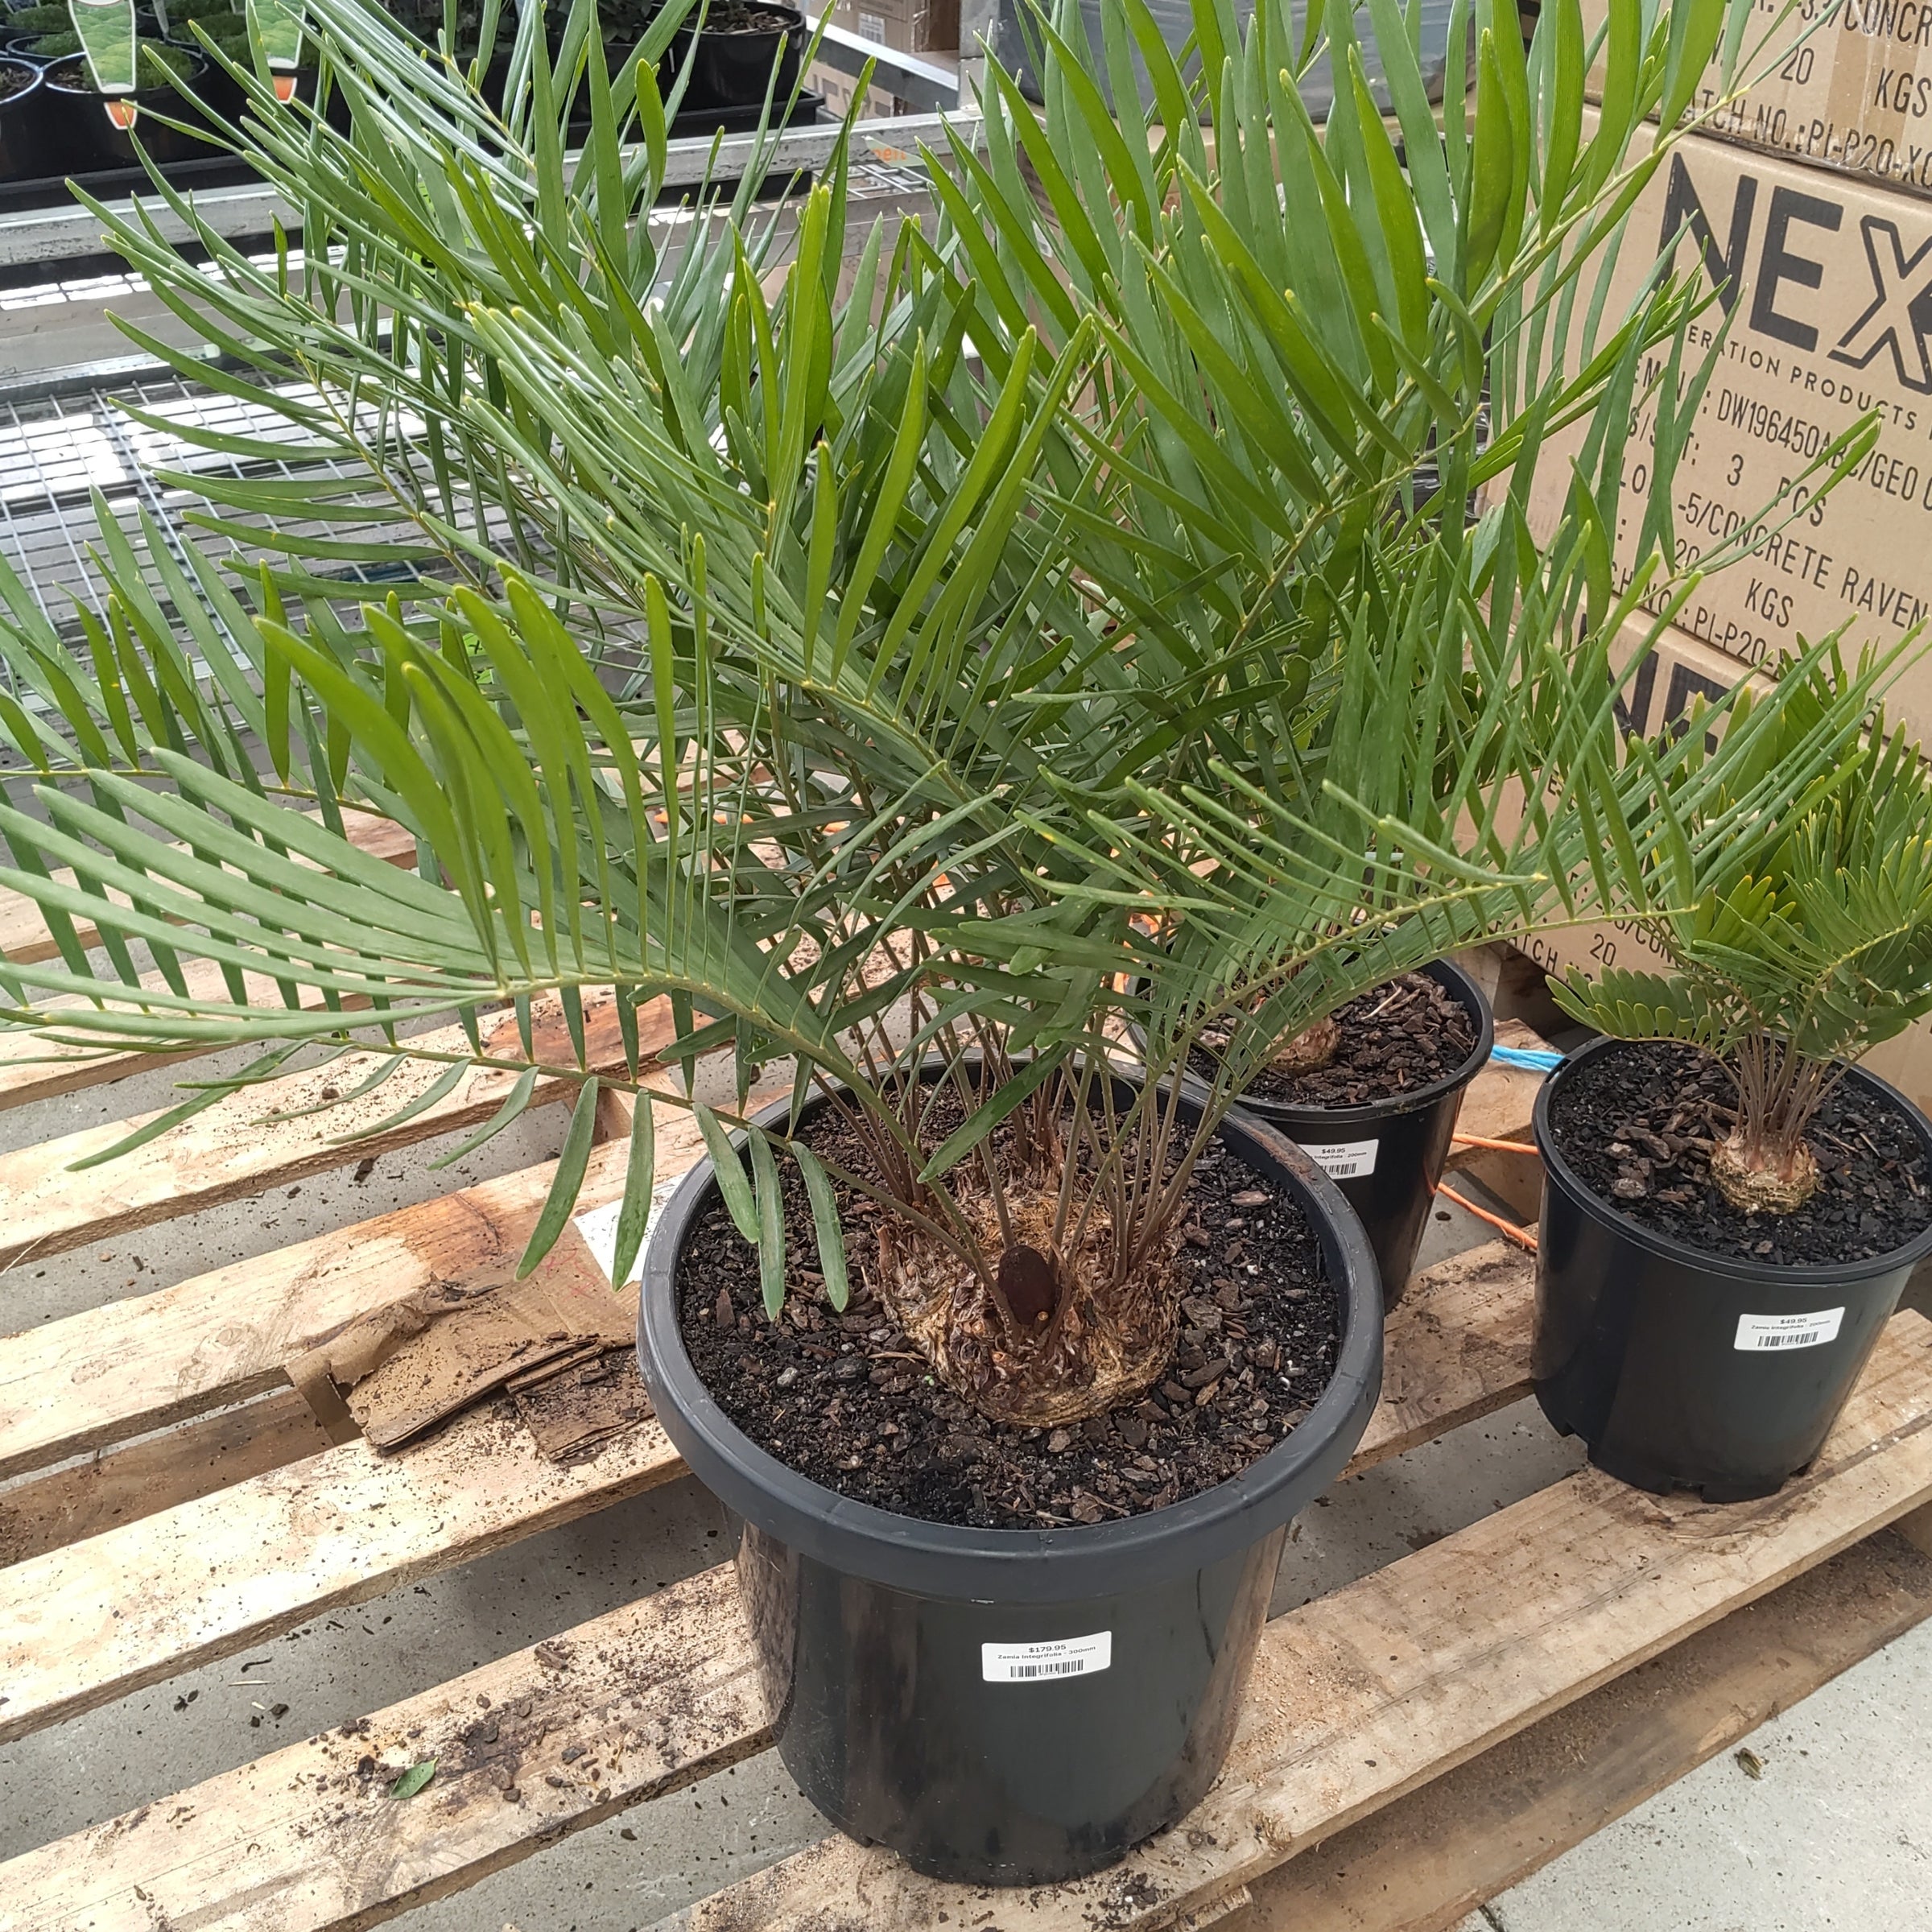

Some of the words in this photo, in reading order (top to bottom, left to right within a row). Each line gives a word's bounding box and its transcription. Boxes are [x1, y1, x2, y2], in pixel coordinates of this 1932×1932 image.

[1780, 46, 1814, 85] 20
[1874, 67, 1932, 118] KGS
[1682, 89, 1746, 135] ATCH
[1727, 454, 1744, 486] 3
[1774, 476, 1827, 527] PCS
[1744, 577, 1794, 628] KGS
[1839, 567, 1929, 636] RAVEN
[1590, 933, 1616, 966] 20
[1022, 1651, 1062, 1659] Integrifolia
[1068, 1645, 1096, 1654] 300mm
[1028, 1644, 1067, 1653] $179.95
